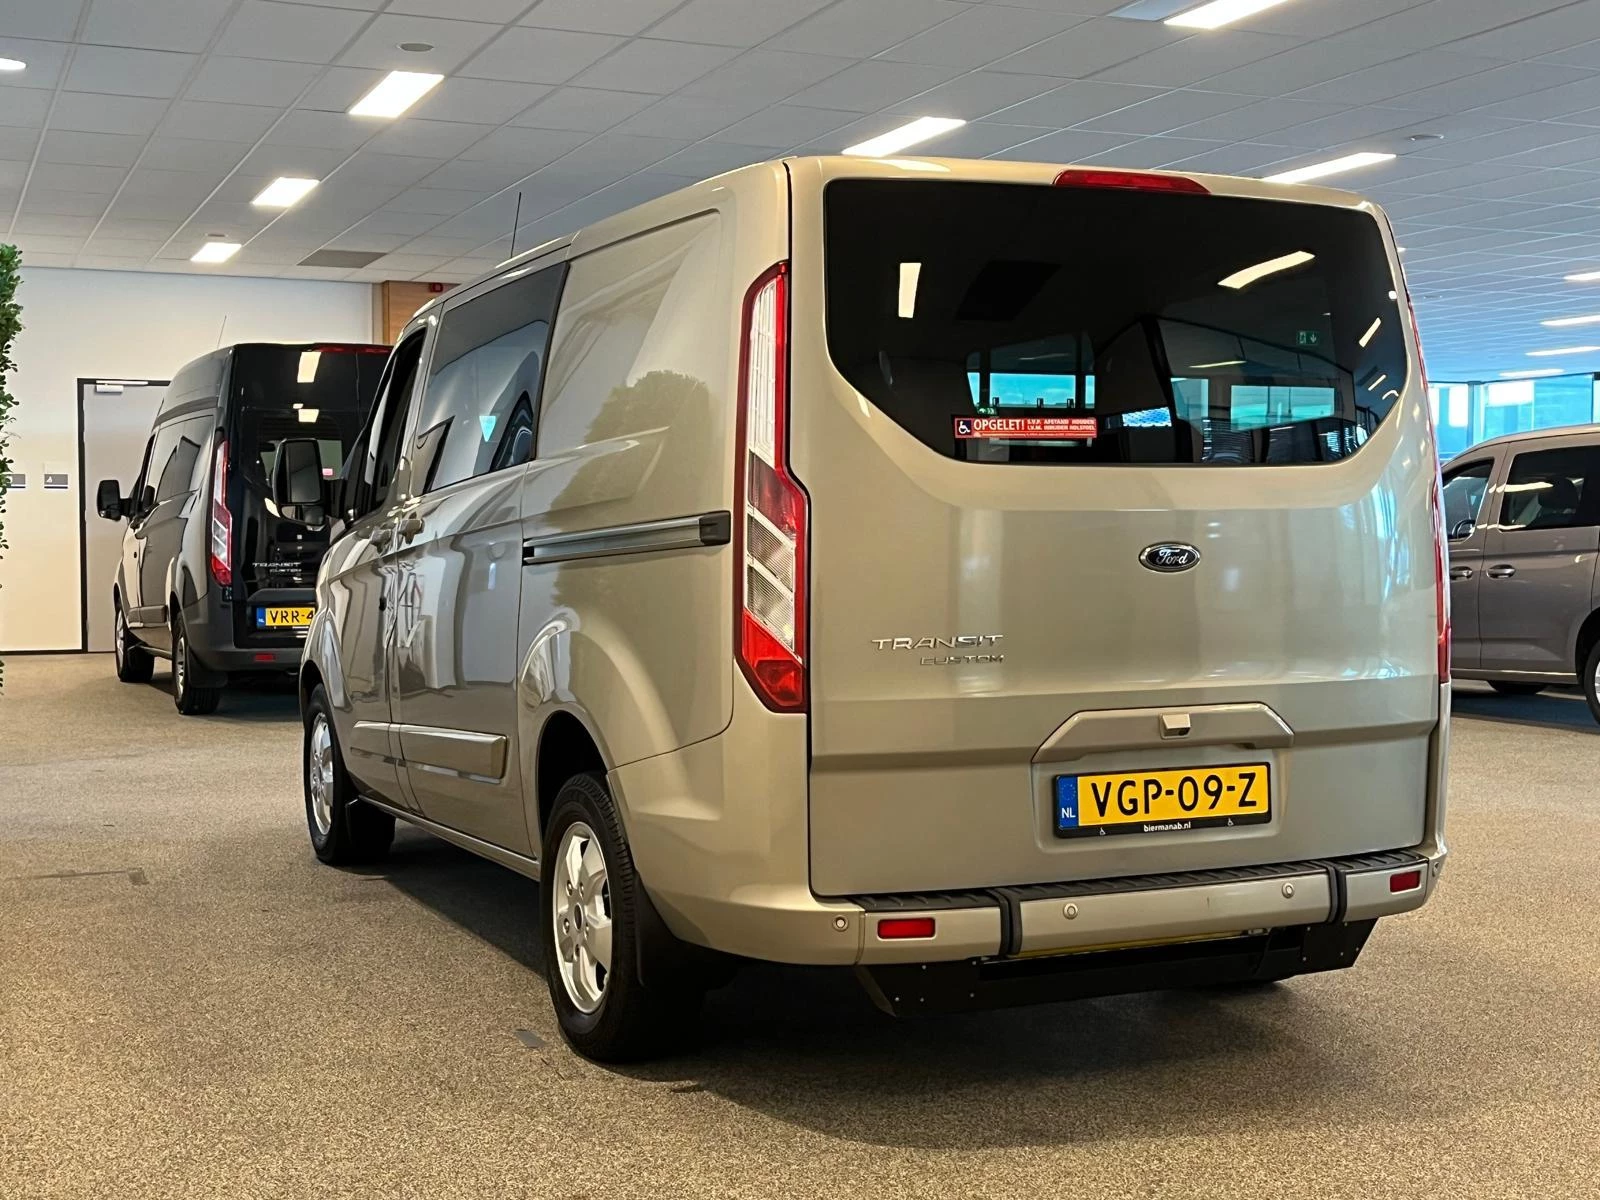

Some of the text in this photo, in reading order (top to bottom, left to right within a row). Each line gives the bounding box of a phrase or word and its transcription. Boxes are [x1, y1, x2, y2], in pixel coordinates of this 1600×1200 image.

[973, 419, 1025, 430] OPGELET!
[1156, 549, 1189, 565] Ford
[872, 635, 1004, 650] TRANSIT
[920, 655, 1005, 665] CUSTOM
[1061, 772, 1257, 819] NL VGP-09-Z
[1143, 821, 1192, 833] biermanab.nl
